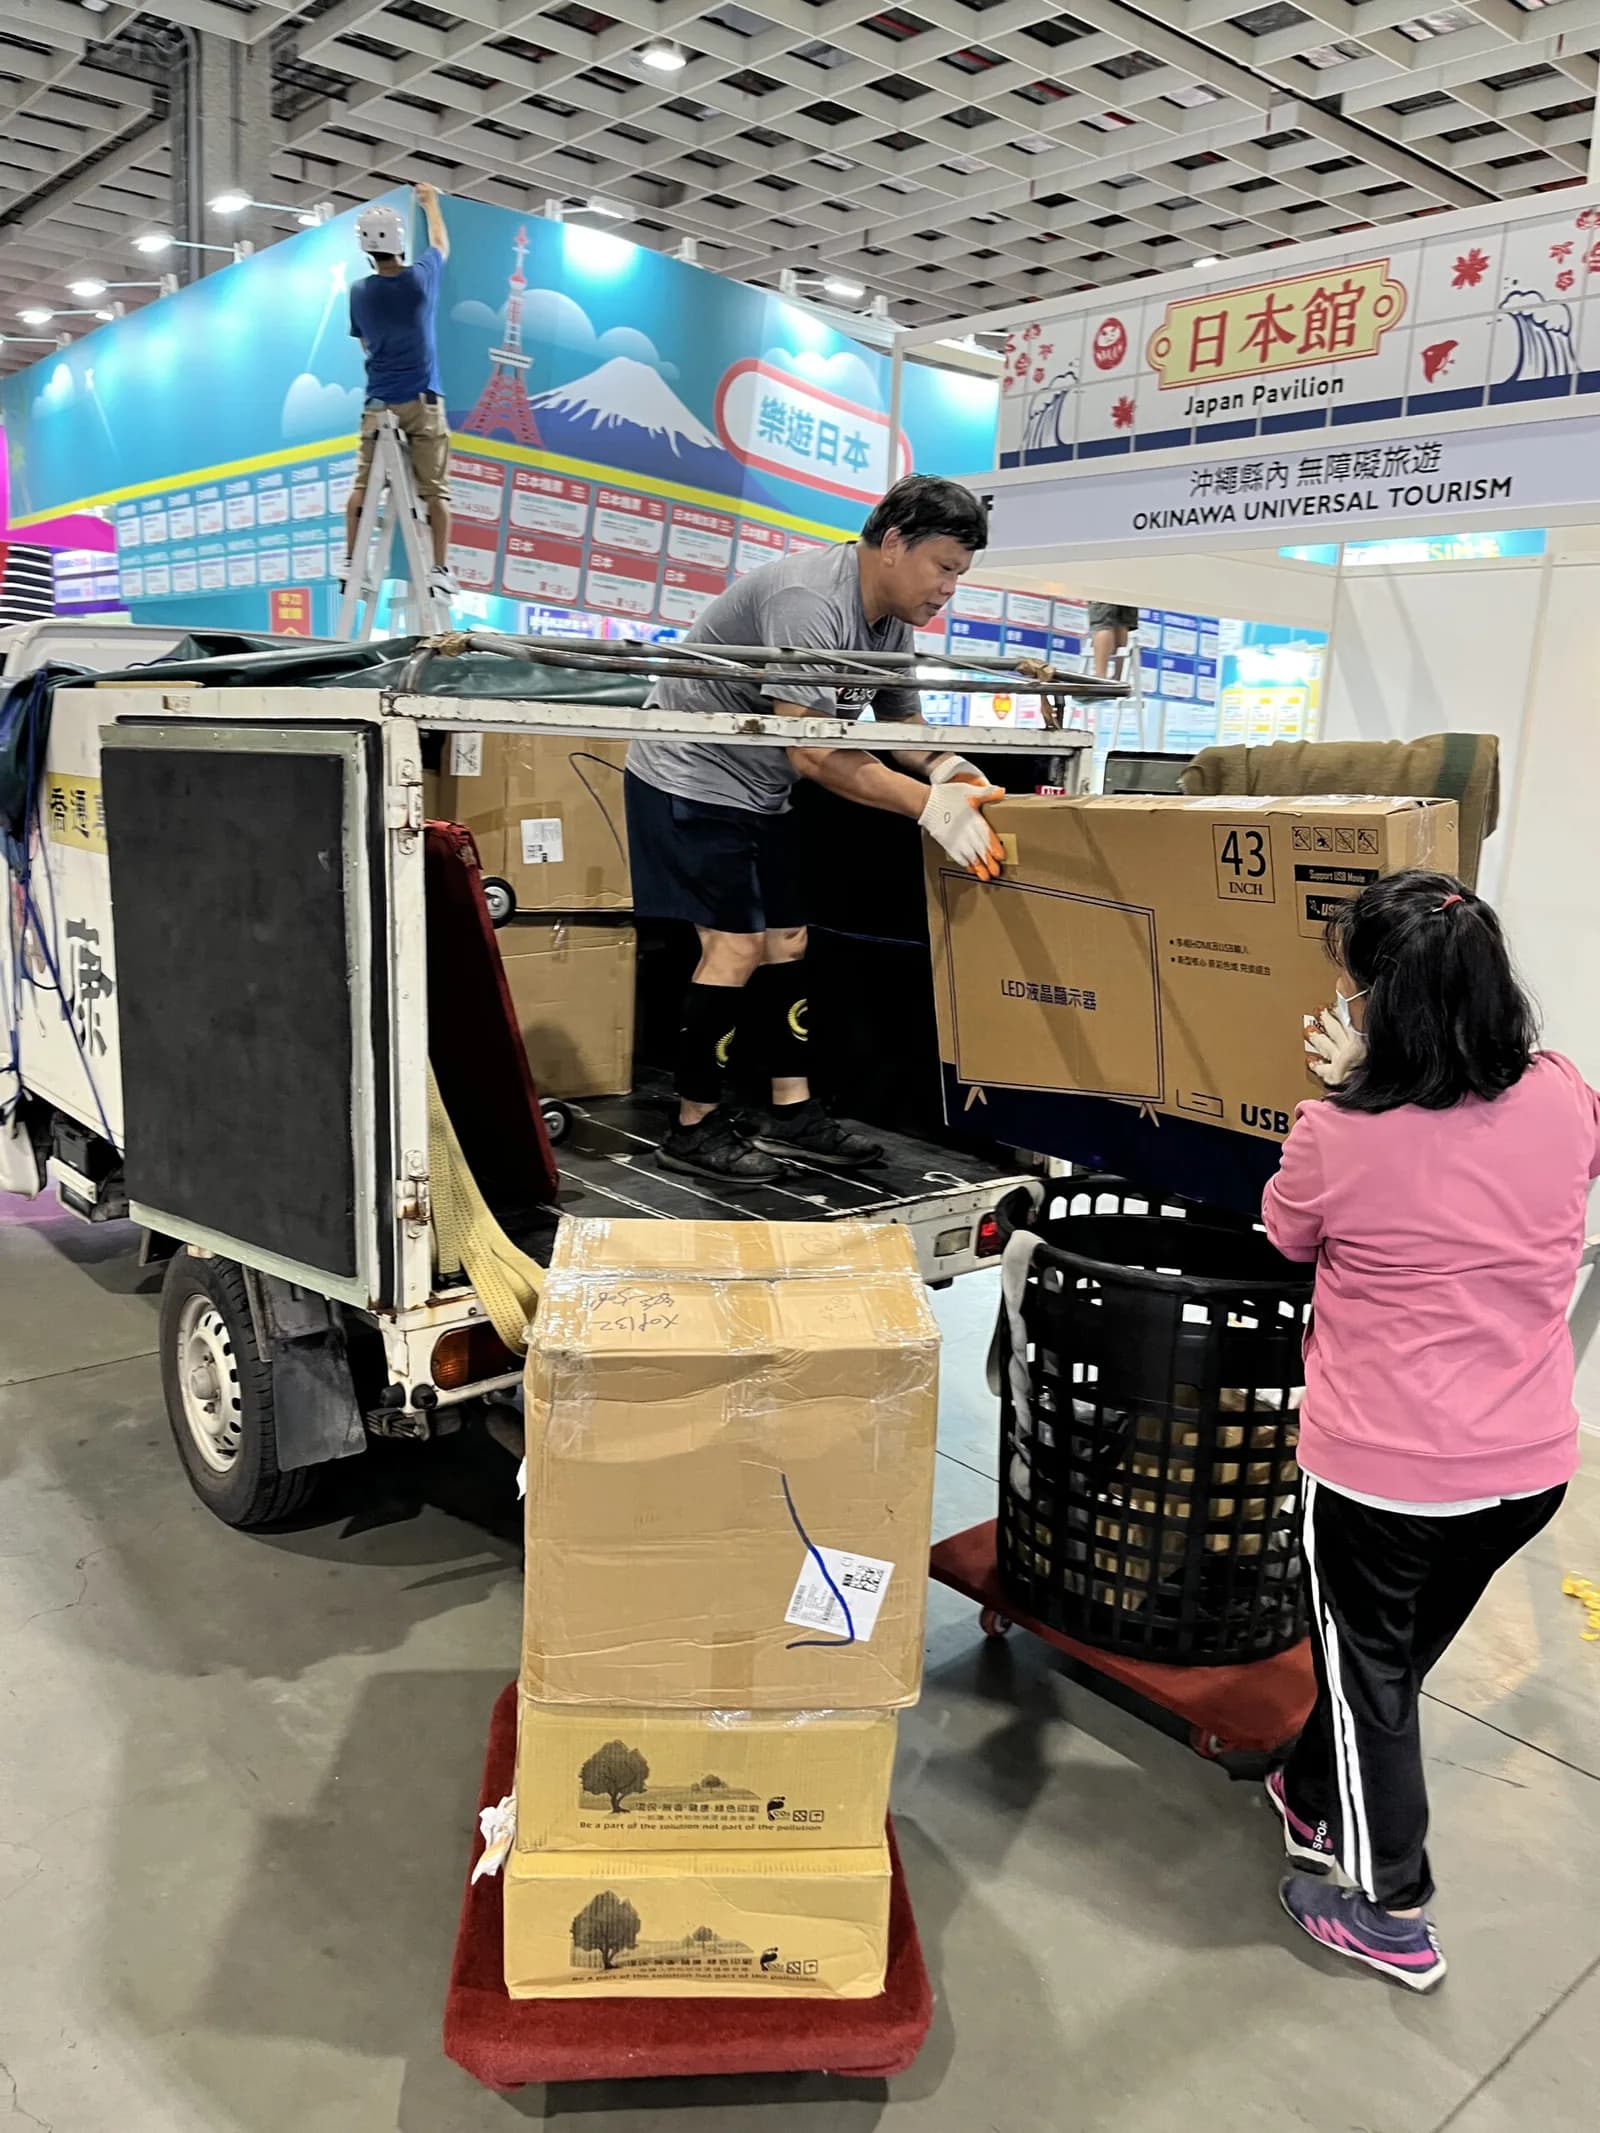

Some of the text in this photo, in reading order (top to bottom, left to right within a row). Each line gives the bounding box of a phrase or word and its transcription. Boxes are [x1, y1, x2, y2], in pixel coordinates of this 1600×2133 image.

[1187, 278, 1367, 373] 日本館
[1184, 376, 1345, 418] Japan Pavilion
[756, 393, 871, 474] 樂遊日本
[1189, 440, 1443, 498] 沖繩縣內 無障礙旅遊
[1132, 475, 1513, 531] OKINAWA UNIVERSAL TOURISM
[509, 538, 535, 552] 日本
[591, 554, 614, 568] 日本
[1221, 830, 1266, 877] 43
[1228, 881, 1263, 896] INCH
[1309, 869, 1333, 881] Support
[1334, 871, 1347, 881] USB
[1001, 979, 1097, 1011] LED液晶顯示器
[1240, 1102, 1290, 1135] USB
[603, 1822, 624, 1831] part
[640, 1822, 656, 1830] the
[721, 1823, 742, 1832] part
[758, 1823, 774, 1831] the
[777, 1824, 822, 1832] pollution
